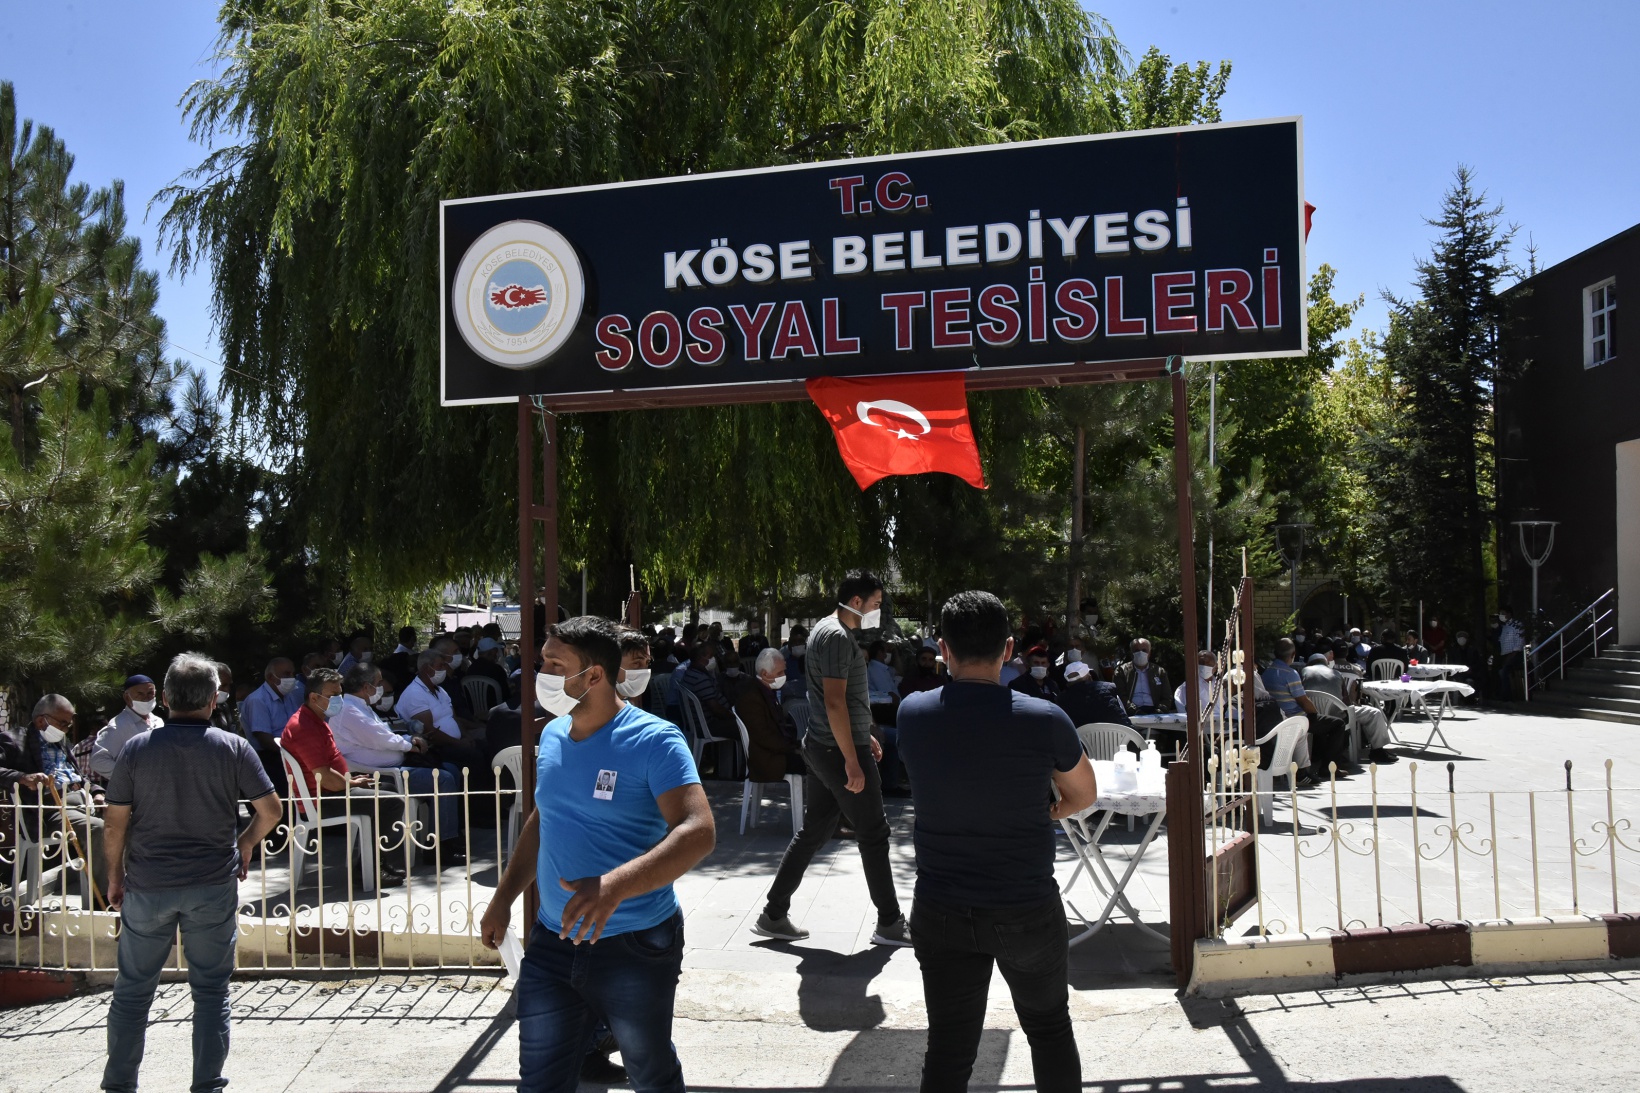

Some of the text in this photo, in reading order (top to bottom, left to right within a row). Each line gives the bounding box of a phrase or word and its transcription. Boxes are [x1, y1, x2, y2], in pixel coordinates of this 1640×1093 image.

[829, 171, 928, 214] T.C.
[663, 196, 1192, 289] KÖSE BELEDİYESİ
[506, 336, 528, 346] 1954
[595, 248, 1282, 371] SOSYAL TESİSLERİ
